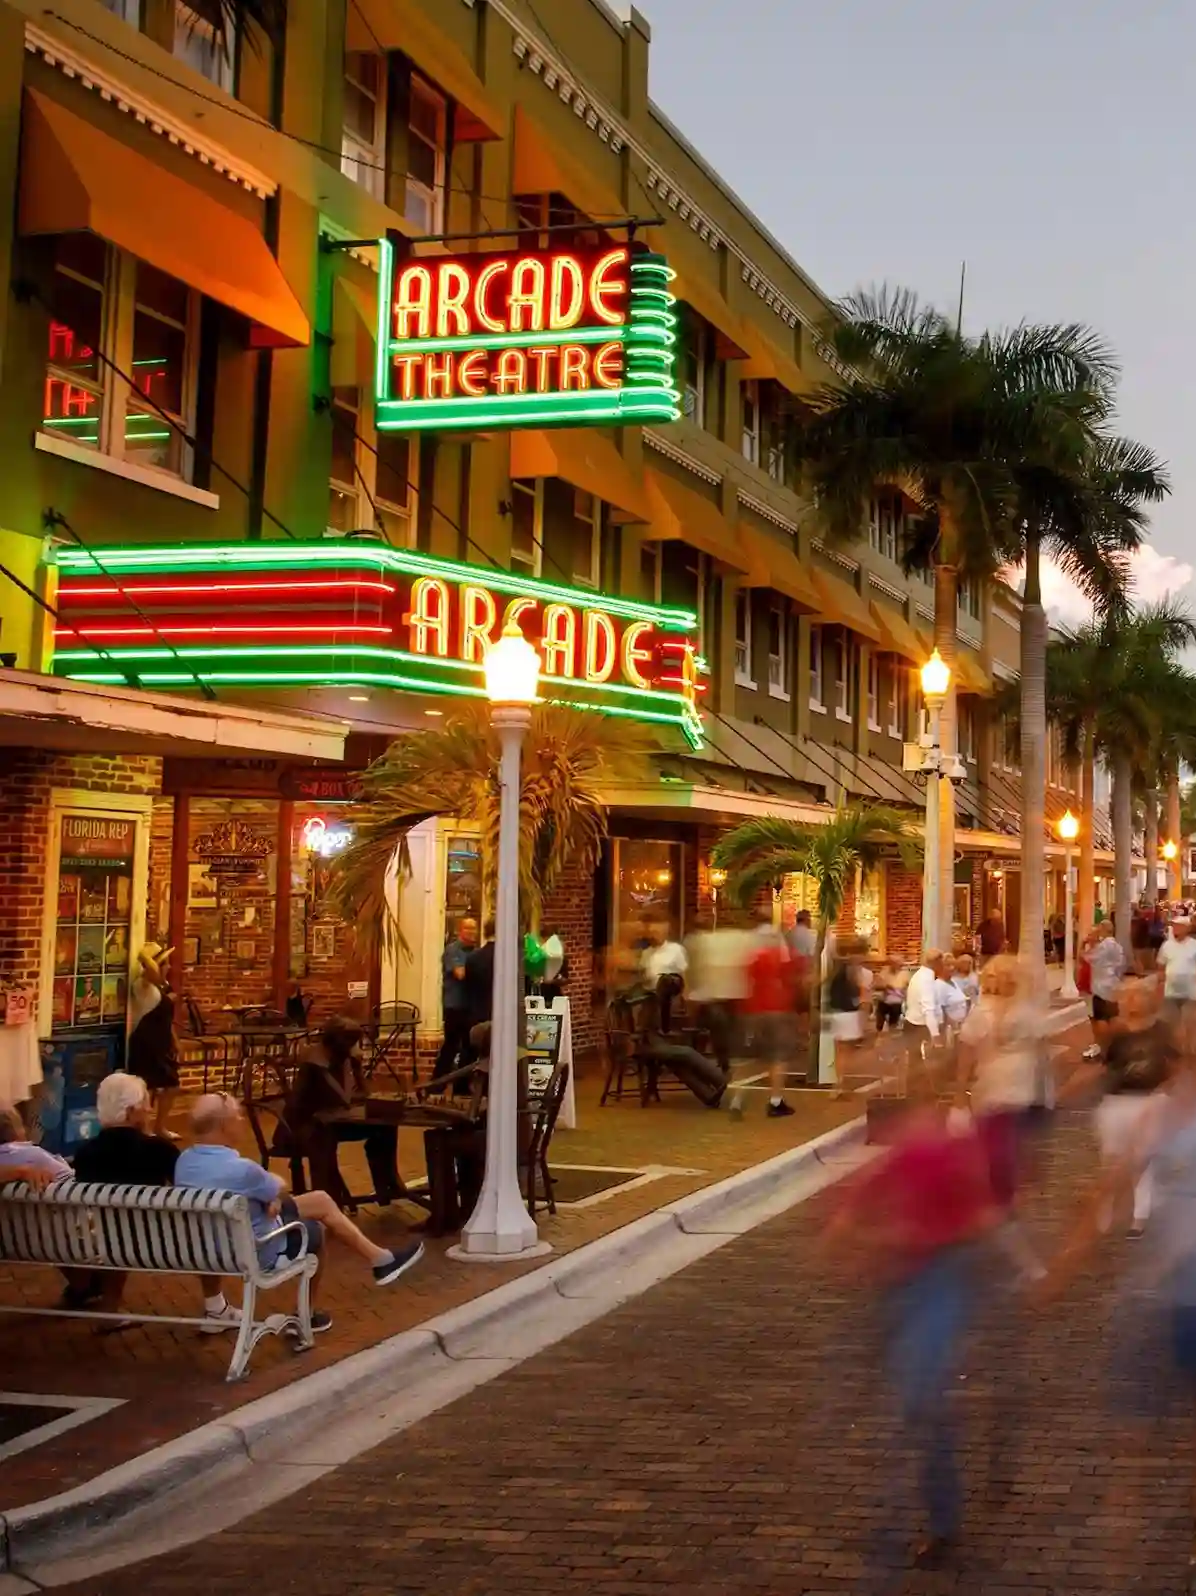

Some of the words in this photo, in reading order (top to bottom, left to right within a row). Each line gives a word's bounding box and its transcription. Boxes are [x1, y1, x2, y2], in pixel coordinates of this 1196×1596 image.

[394, 249, 628, 339] ARCADE
[393, 341, 624, 401] THEATRE
[63, 819, 106, 839] FLORIDA
[109, 823, 128, 840] REP
